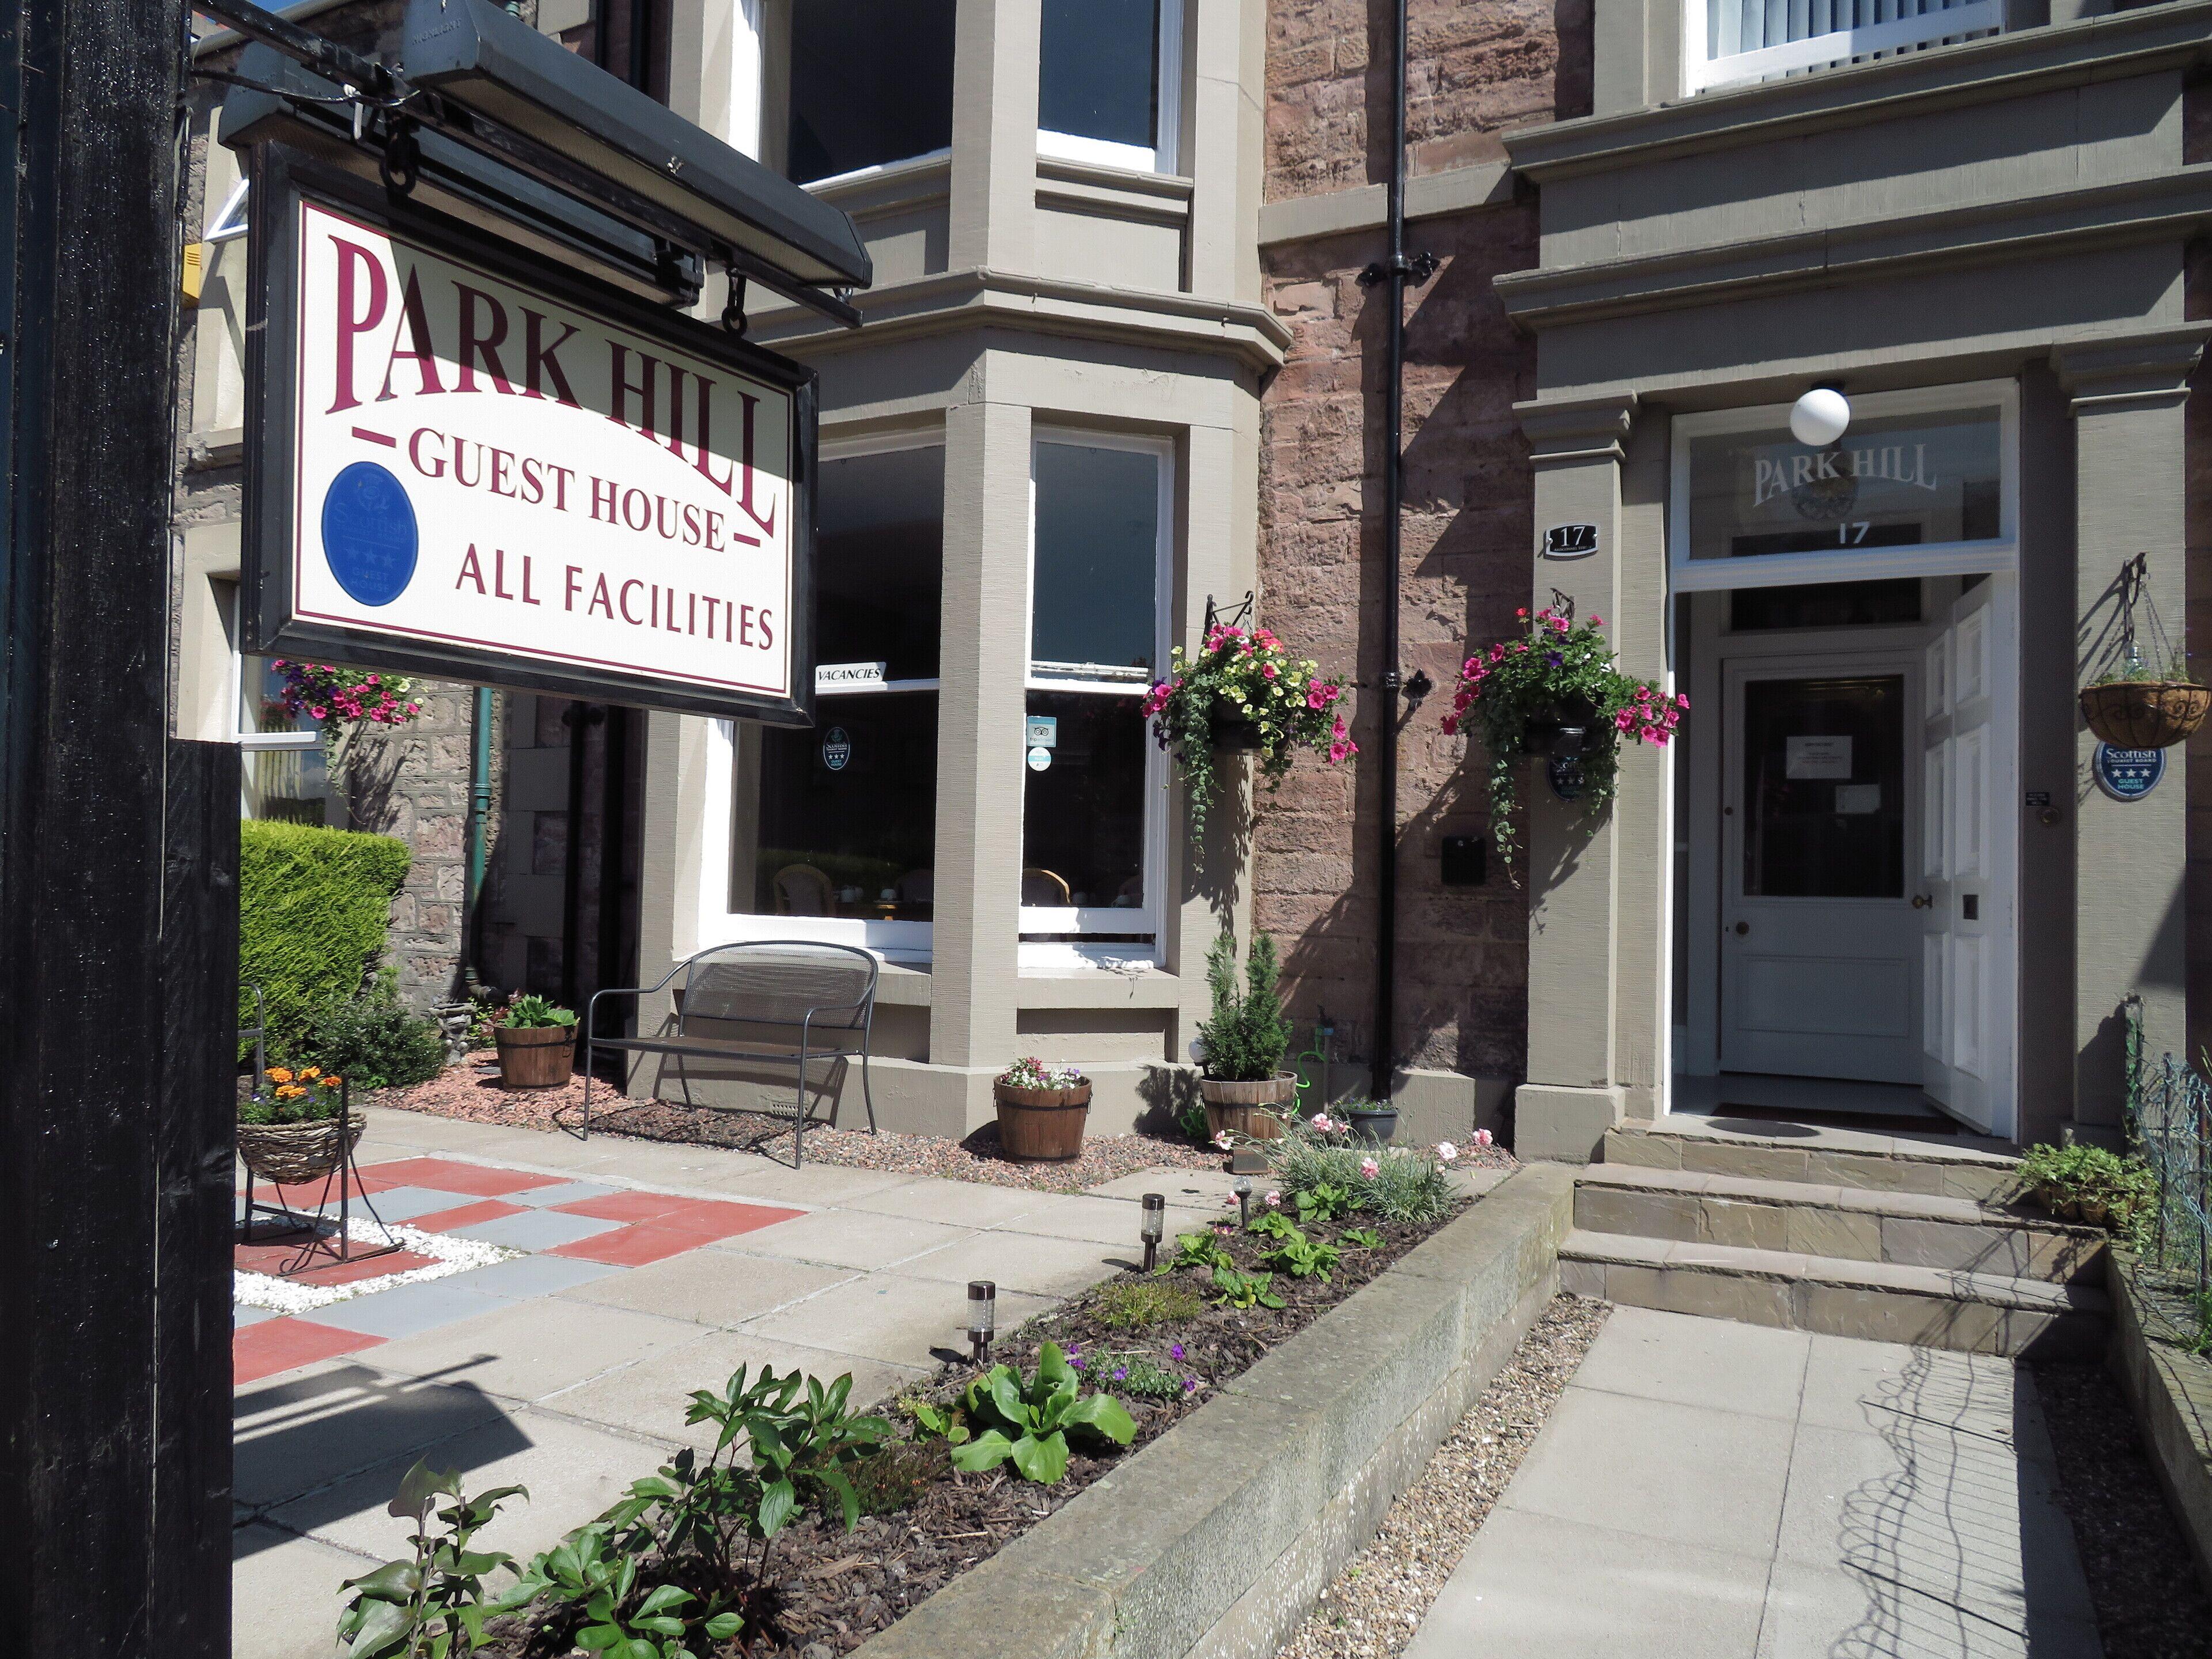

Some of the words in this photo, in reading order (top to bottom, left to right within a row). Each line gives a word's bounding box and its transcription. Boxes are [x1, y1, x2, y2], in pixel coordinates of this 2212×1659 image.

[325, 234, 583, 415] PARK
[605, 339, 776, 537] HILL
[408, 427, 574, 512] GUEST
[589, 475, 725, 553] HOUSE
[1753, 451, 1842, 507] PARK
[1850, 443, 1937, 490] HILL
[1560, 526, 1585, 547] 17
[1839, 521, 1871, 544] 17
[456, 543, 541, 606] ALL
[564, 565, 774, 651] FACILITIES
[818, 668, 881, 681] VACANCIES
[2106, 748, 2157, 759] Scottish
